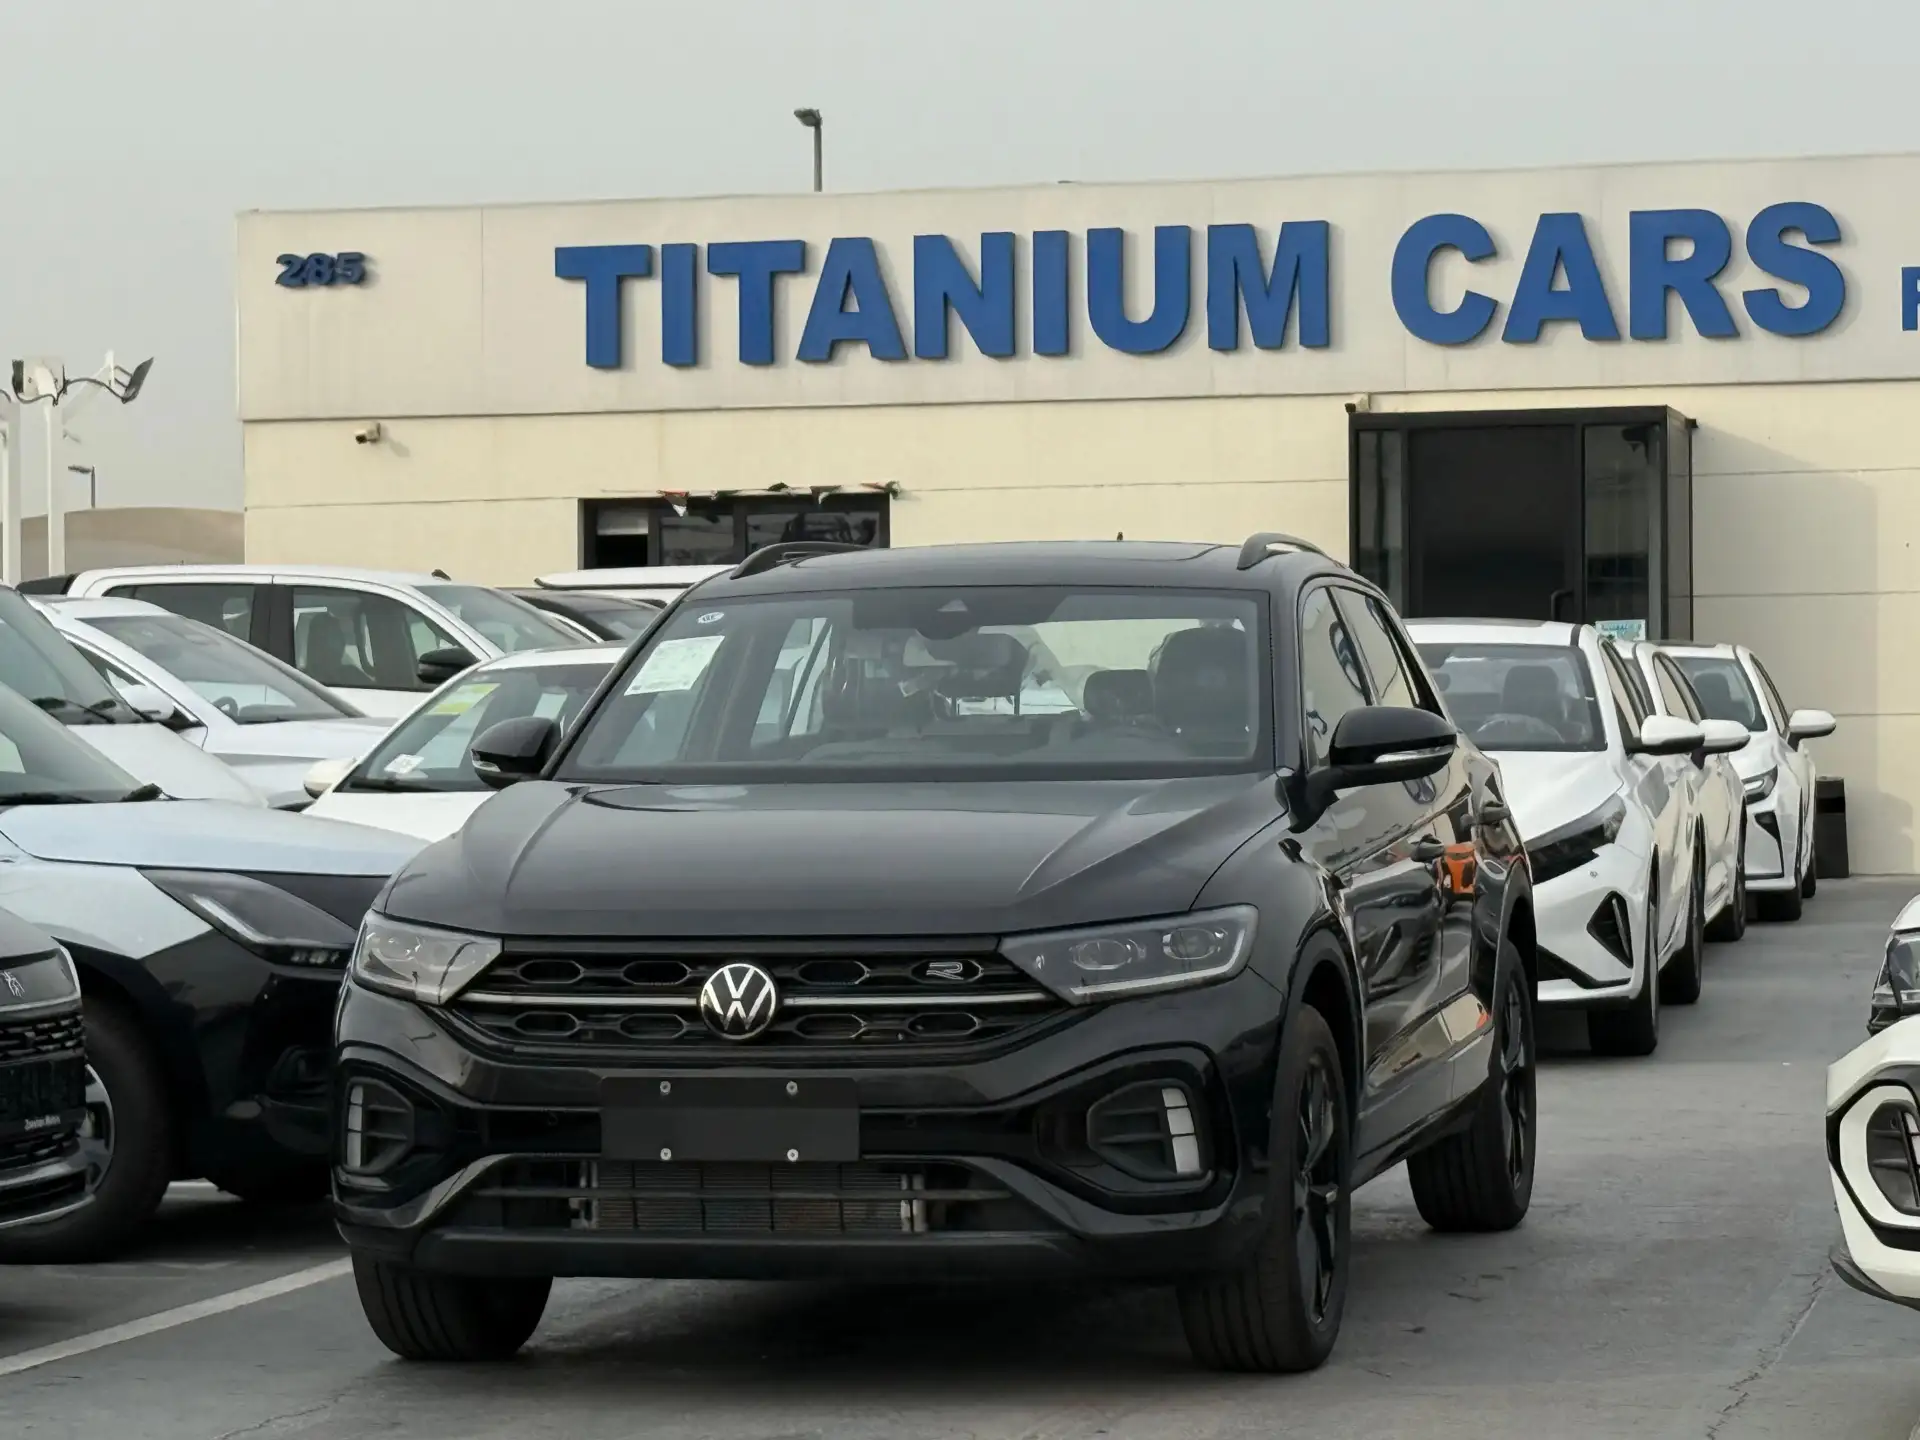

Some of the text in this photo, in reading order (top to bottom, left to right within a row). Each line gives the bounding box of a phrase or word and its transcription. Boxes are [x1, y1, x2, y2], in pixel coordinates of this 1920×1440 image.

[275, 252, 366, 287] 285
[555, 220, 1331, 368] TITANIUM
[1391, 201, 1846, 345] CARS
